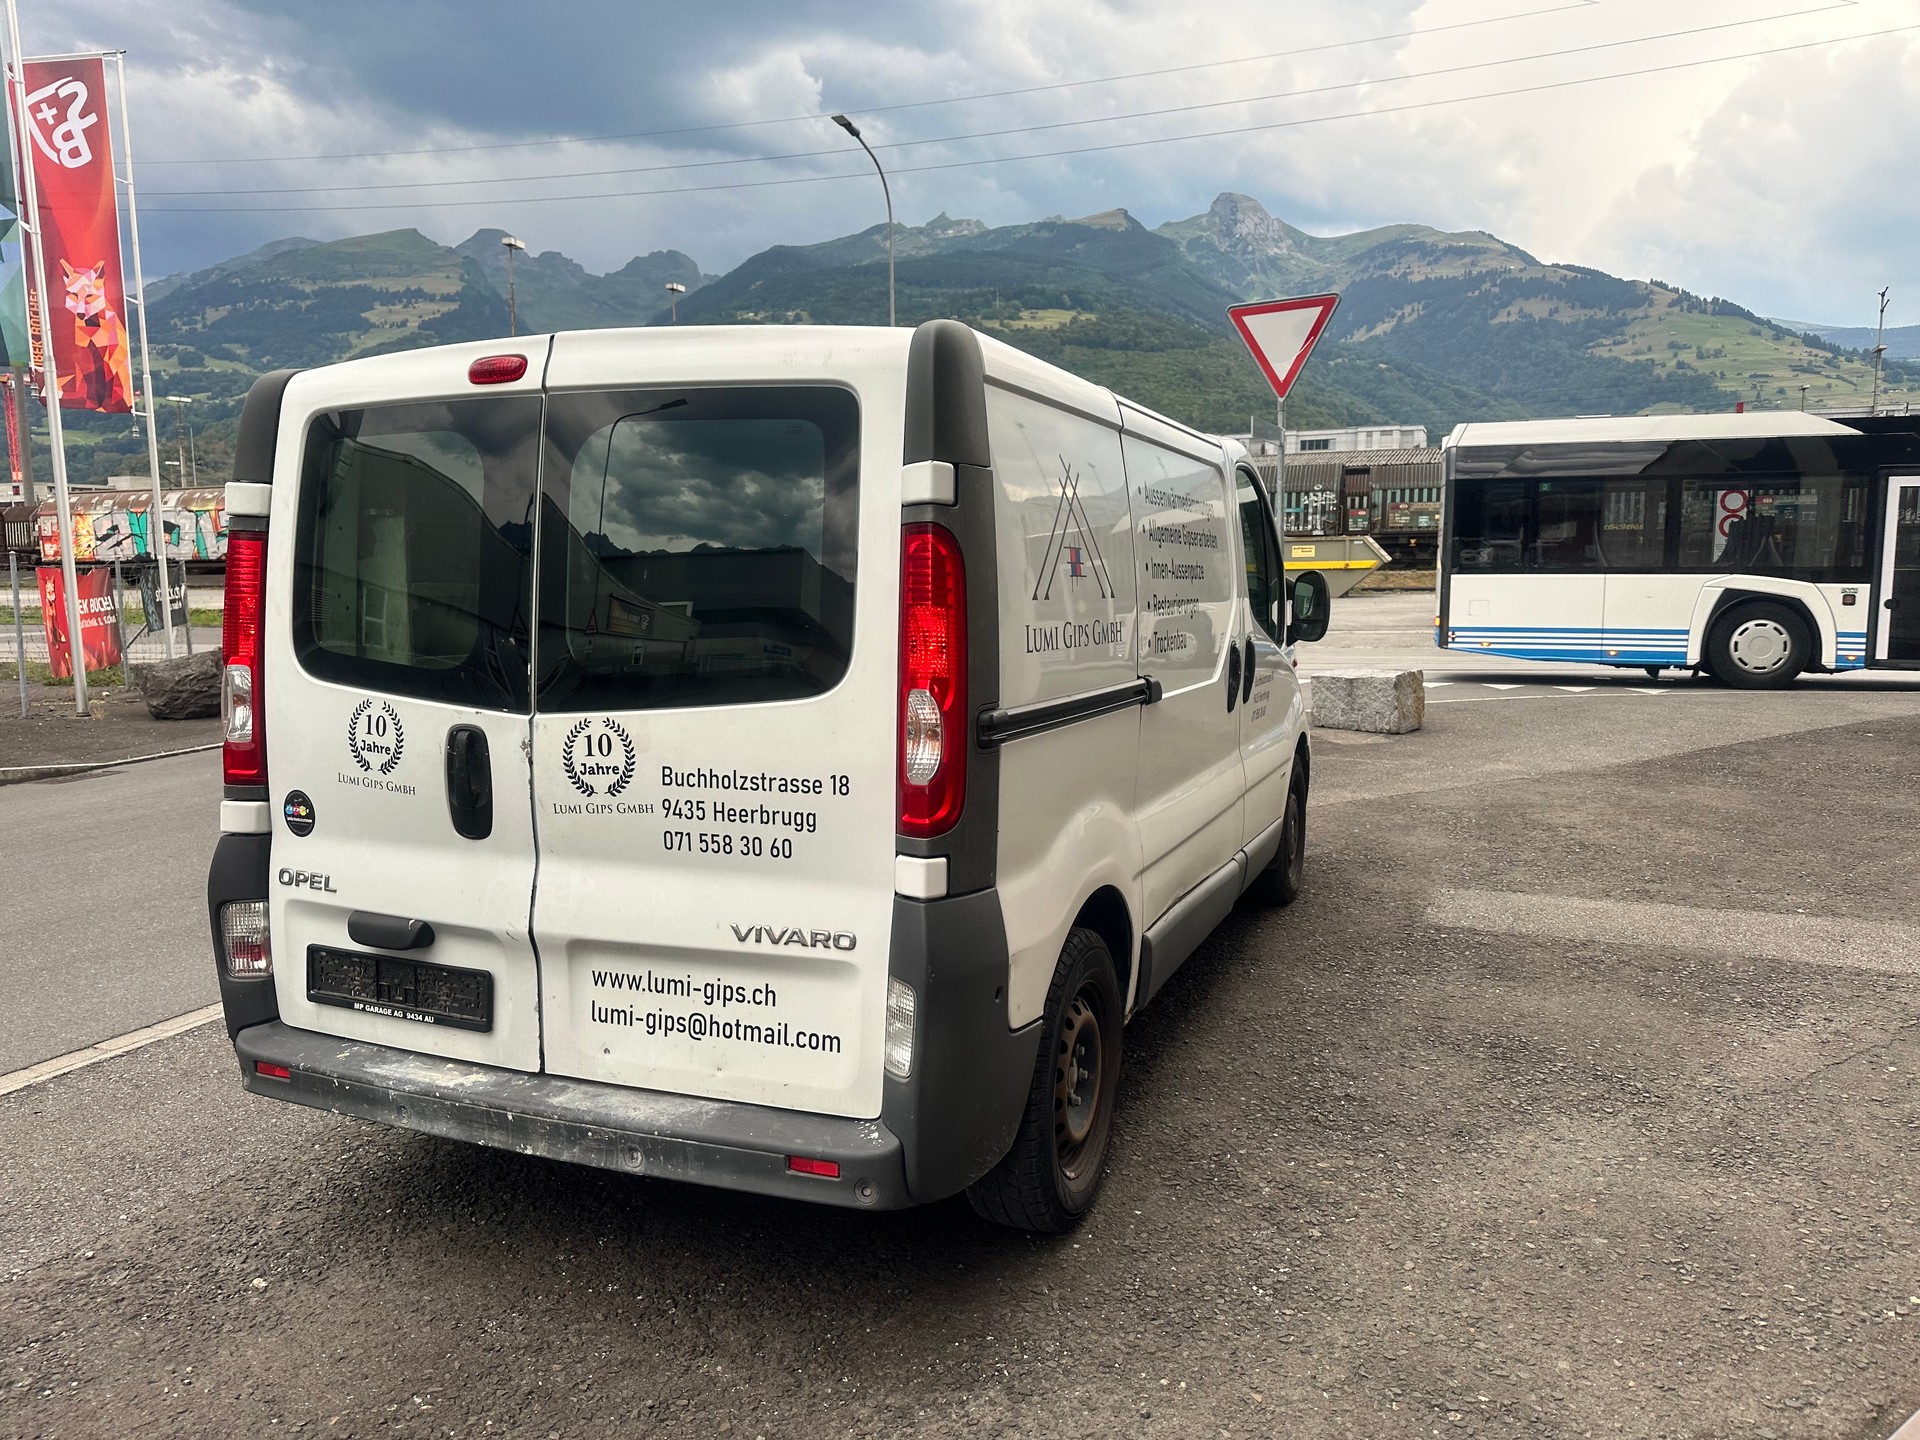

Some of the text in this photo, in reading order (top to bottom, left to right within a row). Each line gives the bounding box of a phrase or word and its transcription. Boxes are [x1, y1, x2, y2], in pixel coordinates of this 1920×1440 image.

[1148, 525, 1218, 551] Allgemeine Gipserarbeiten
[1150, 556, 1205, 585] Innen-Aussenputze
[1152, 593, 1200, 619] Restaurierungen
[1025, 624, 1060, 654] LUMI
[1062, 621, 1090, 648] GIPS
[1153, 631, 1187, 655] Trockenbau
[364, 713, 387, 738] 10
[359, 738, 392, 756] Jahre
[583, 732, 613, 758] 10
[337, 772, 361, 786] LUMI
[362, 776, 384, 791] GIPS
[578, 762, 620, 777] Jahre
[661, 766, 850, 796] Buchholzstrasse 18
[552, 802, 582, 815] LUMI
[585, 802, 613, 815] GIPS
[661, 798, 817, 833] 9435 Heerbrugg
[663, 831, 793, 859] 071 558 30 60
[278, 867, 338, 893] OPEL
[730, 923, 857, 952] VIVARO
[591, 969, 777, 1008] www.lumi-gips.ch
[354, 1002, 434, 1023] MP GARAGE AG 9434 AU
[591, 1000, 841, 1054] lumi-gips@hotmail.com
